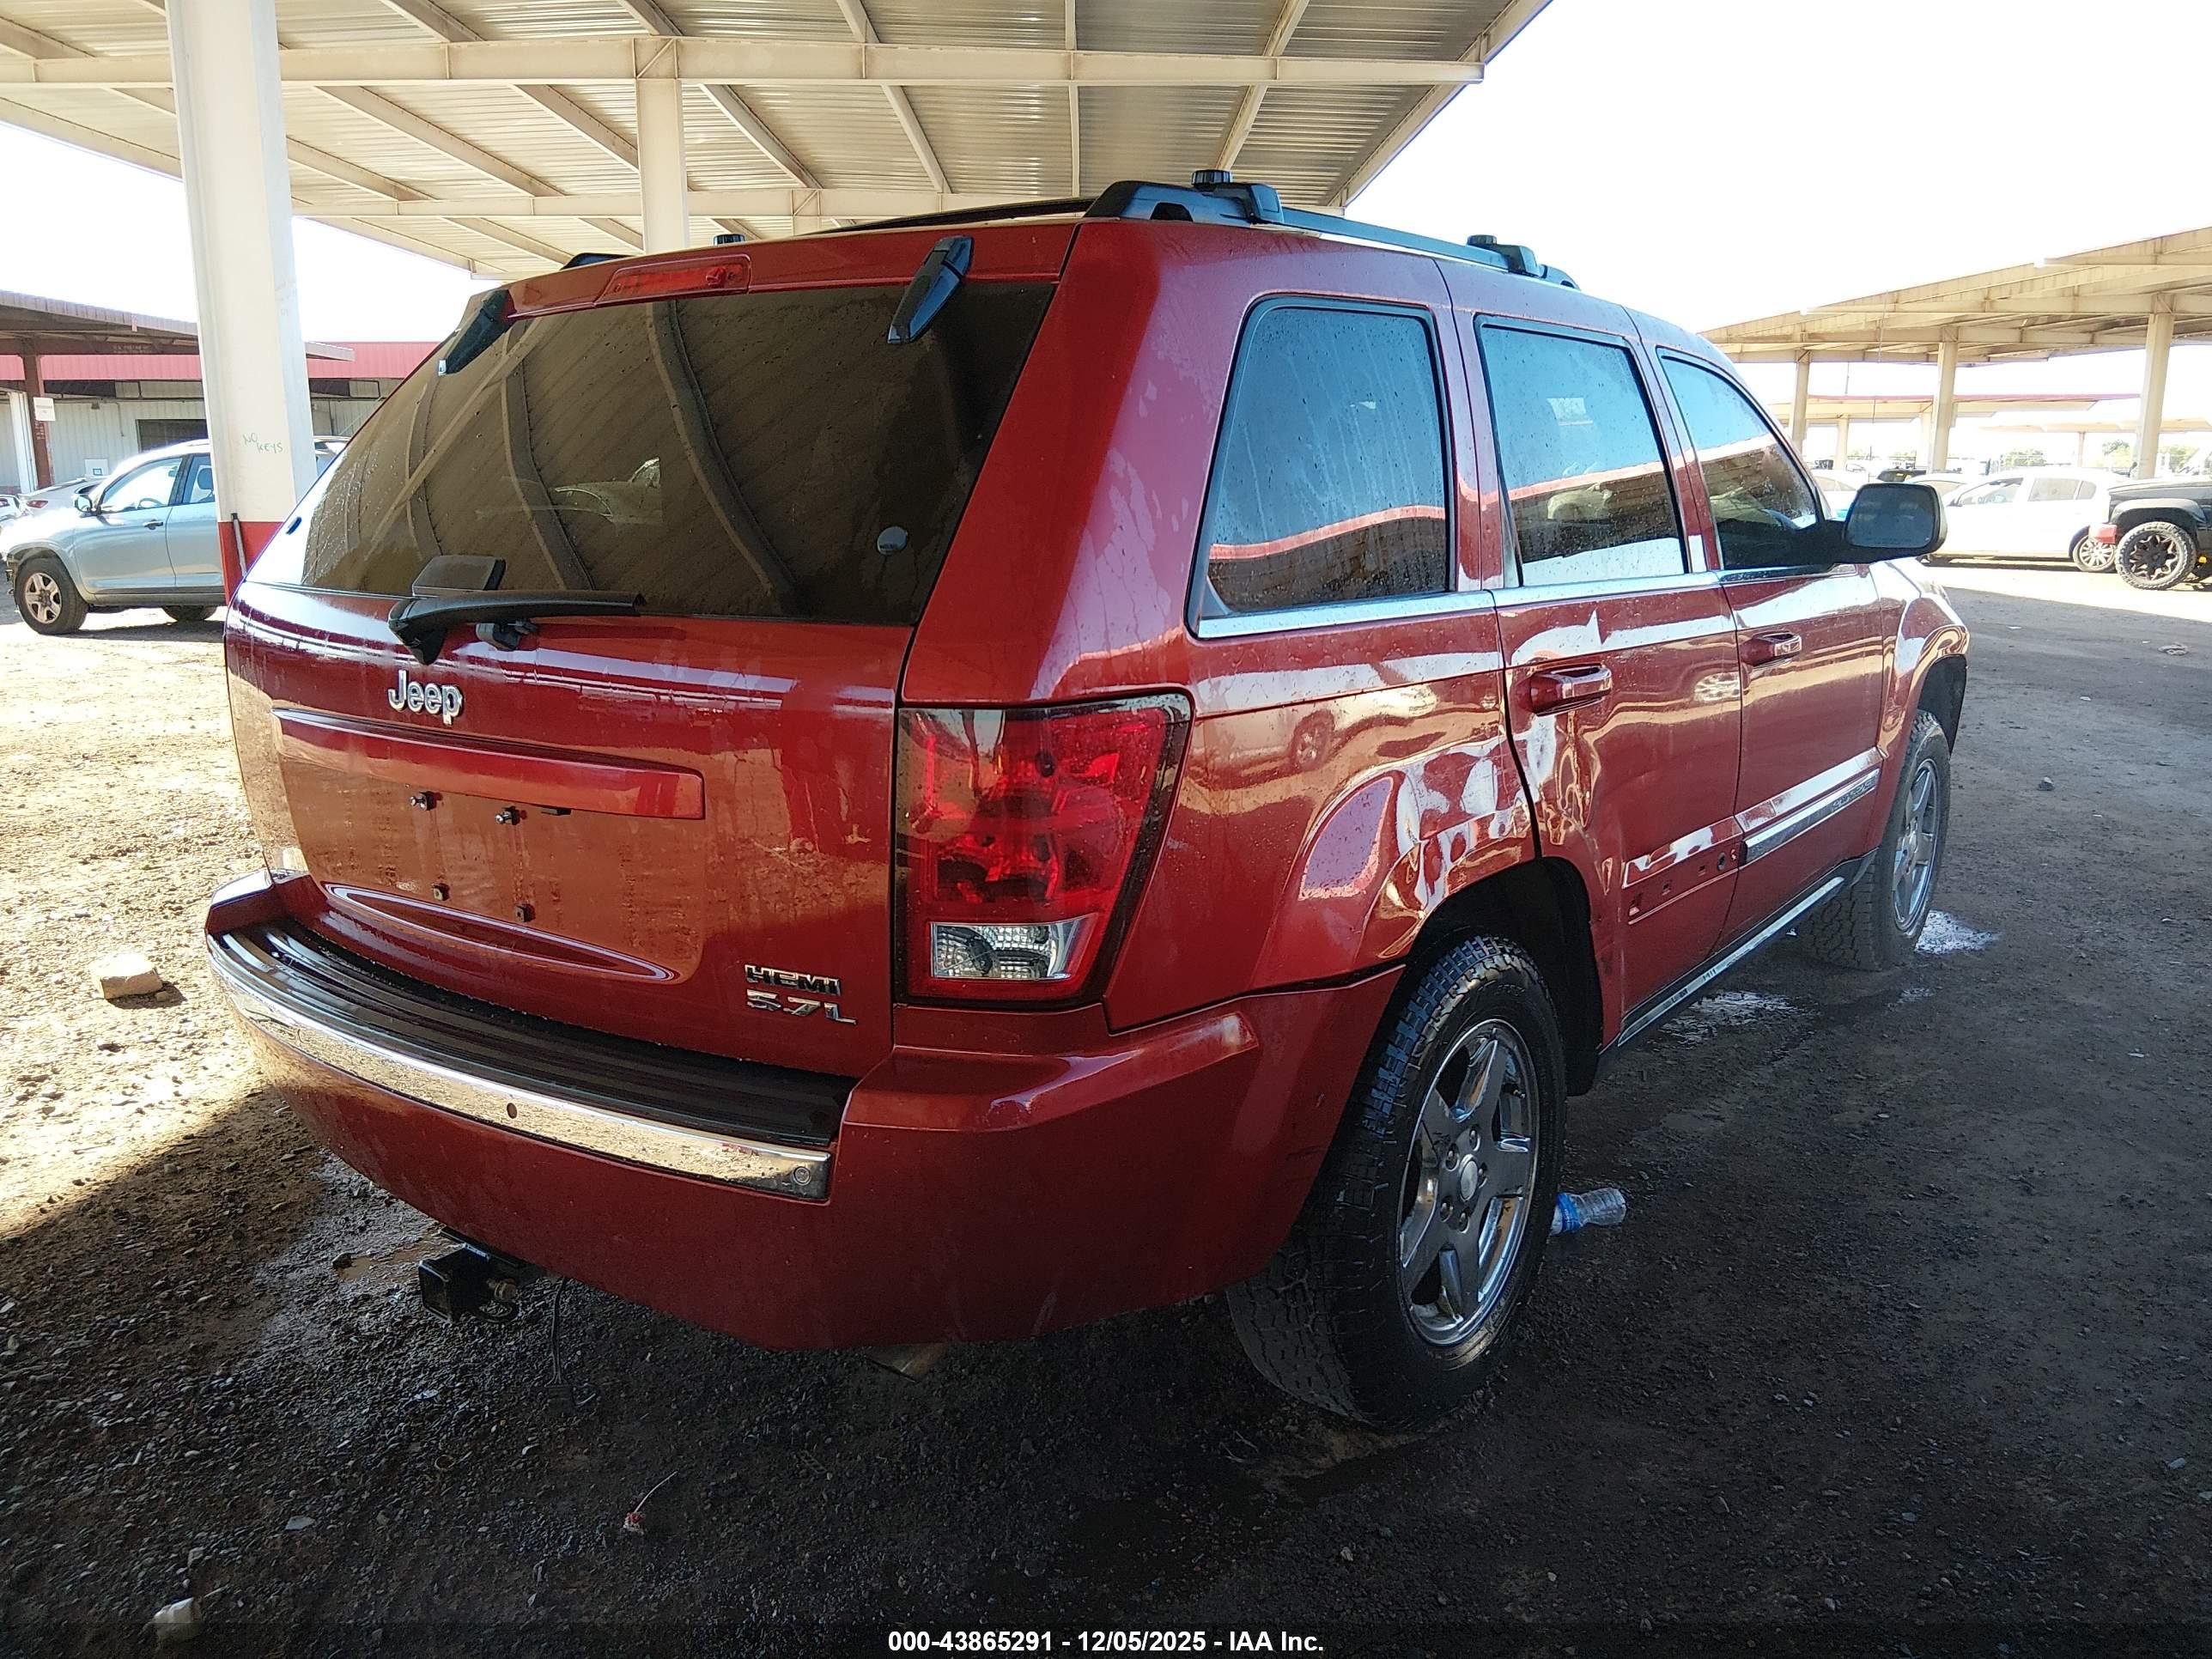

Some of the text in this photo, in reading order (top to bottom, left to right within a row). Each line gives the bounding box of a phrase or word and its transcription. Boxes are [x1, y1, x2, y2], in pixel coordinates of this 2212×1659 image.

[387, 670, 463, 725] Jeep
[744, 964, 841, 996] HEMI
[746, 989, 857, 1024] 5.7L
